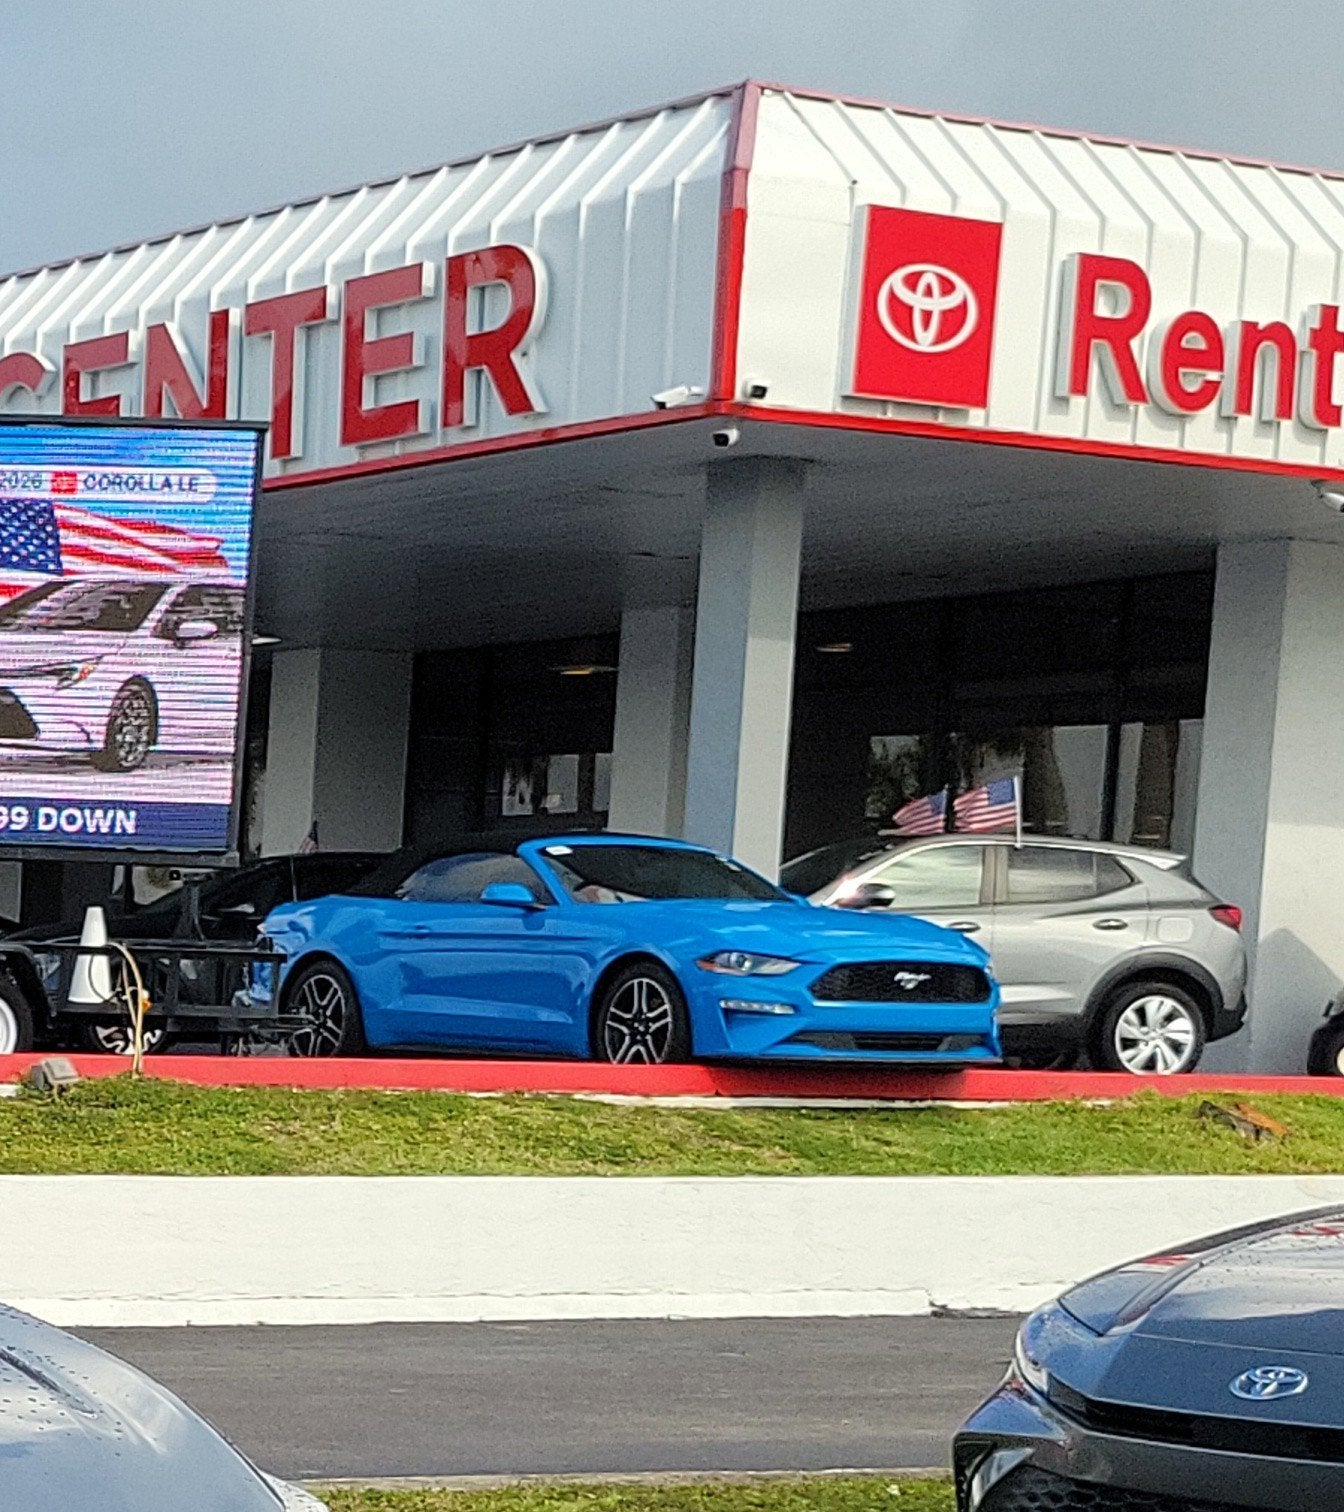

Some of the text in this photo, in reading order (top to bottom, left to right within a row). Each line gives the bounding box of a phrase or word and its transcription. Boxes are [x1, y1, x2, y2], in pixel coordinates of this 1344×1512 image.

[1057, 252, 1344, 430] Rent
[83, 475, 172, 492] COROLLA
[178, 477, 200, 493] LE
[38, 806, 137, 834] DOWN
